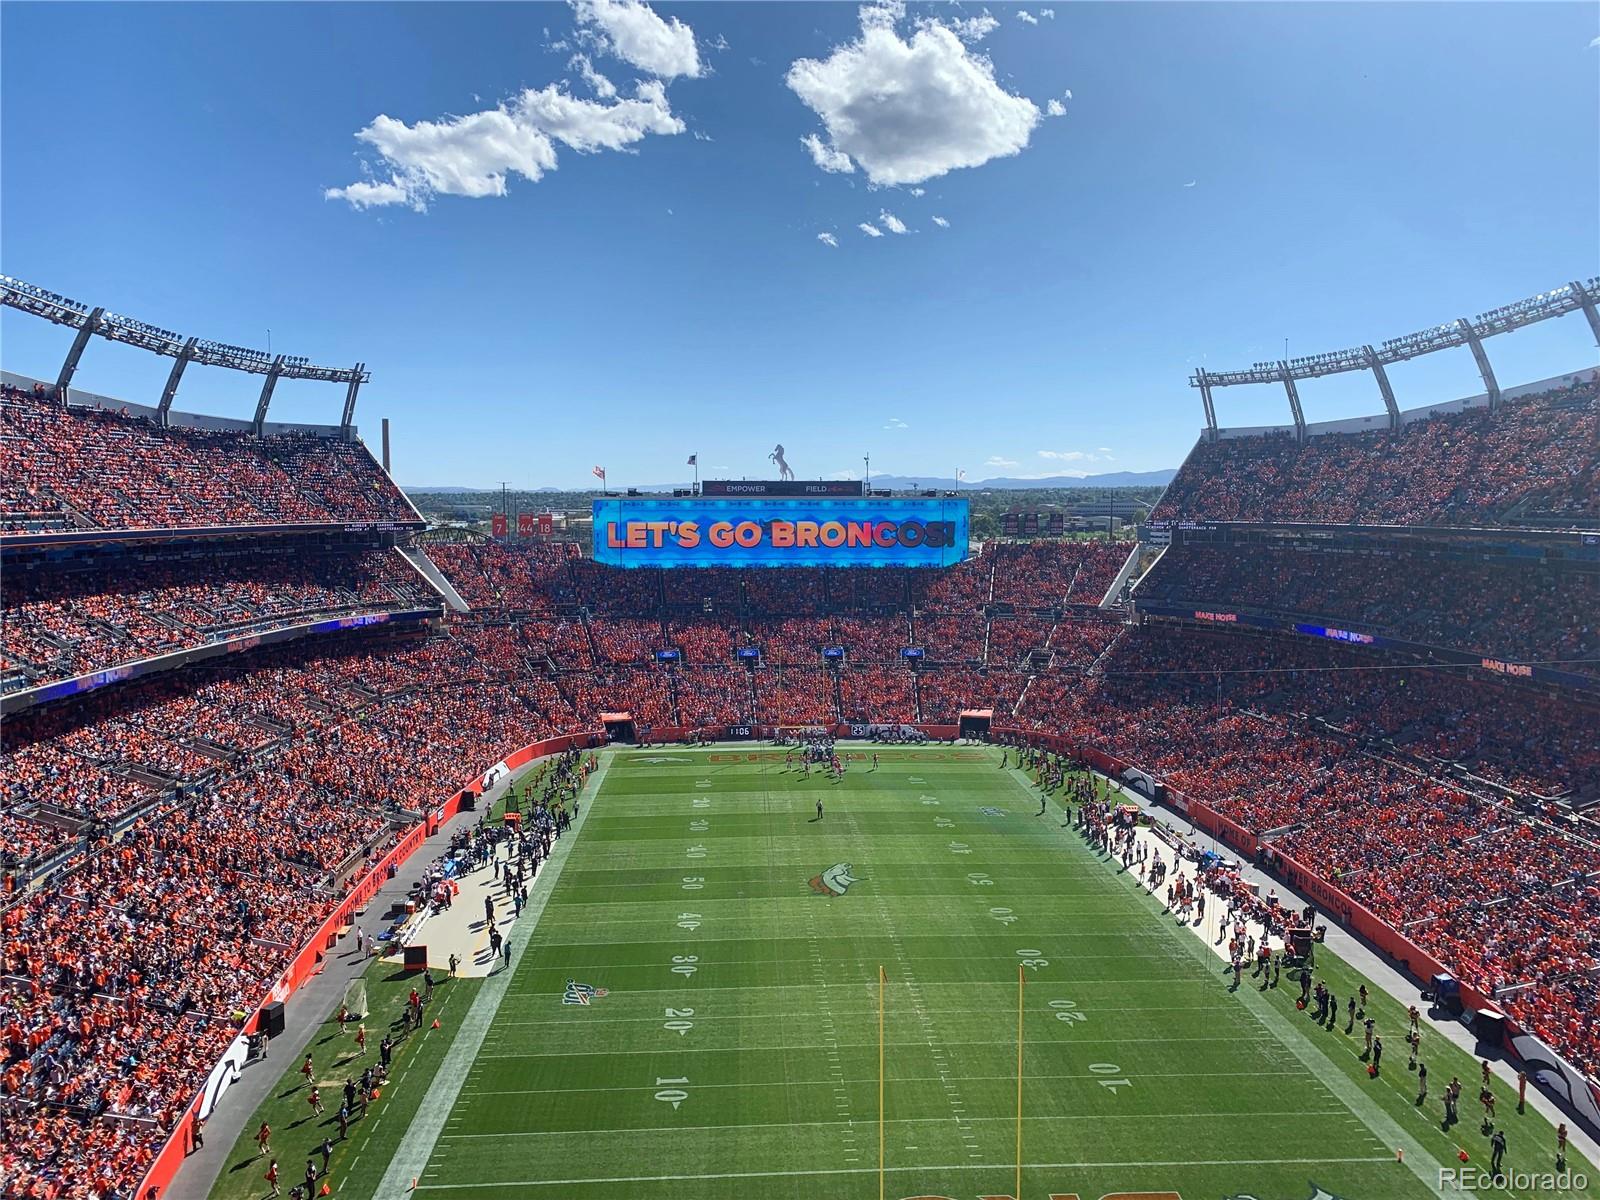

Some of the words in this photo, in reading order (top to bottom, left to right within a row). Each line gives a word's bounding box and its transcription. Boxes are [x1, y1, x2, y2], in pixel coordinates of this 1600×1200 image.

[726, 485, 766, 493] EMPOWER
[805, 485, 827, 493] FIELD
[540, 523, 551, 533] 18
[606, 521, 700, 548] LET'S
[708, 521, 762, 548] GO
[771, 520, 955, 548] BRONCOS!
[1195, 611, 1215, 621] MAKE
[1482, 658, 1505, 673] MAKE
[1506, 663, 1532, 677] NOISE
[853, 726, 863, 735] 25
[707, 754, 985, 763] BRCOS
[398, 831, 422, 861] COUNTRY
[681, 876, 705, 890] 50
[1311, 882, 1353, 919] BRONCOS
[676, 912, 702, 928] 40
[671, 955, 698, 973] 30
[1015, 949, 1049, 966] 30
[663, 1008, 694, 1029] 20
[1047, 1000, 1088, 1021] 20
[1088, 1063, 1133, 1087] 10
[654, 1077, 689, 1101] 10
